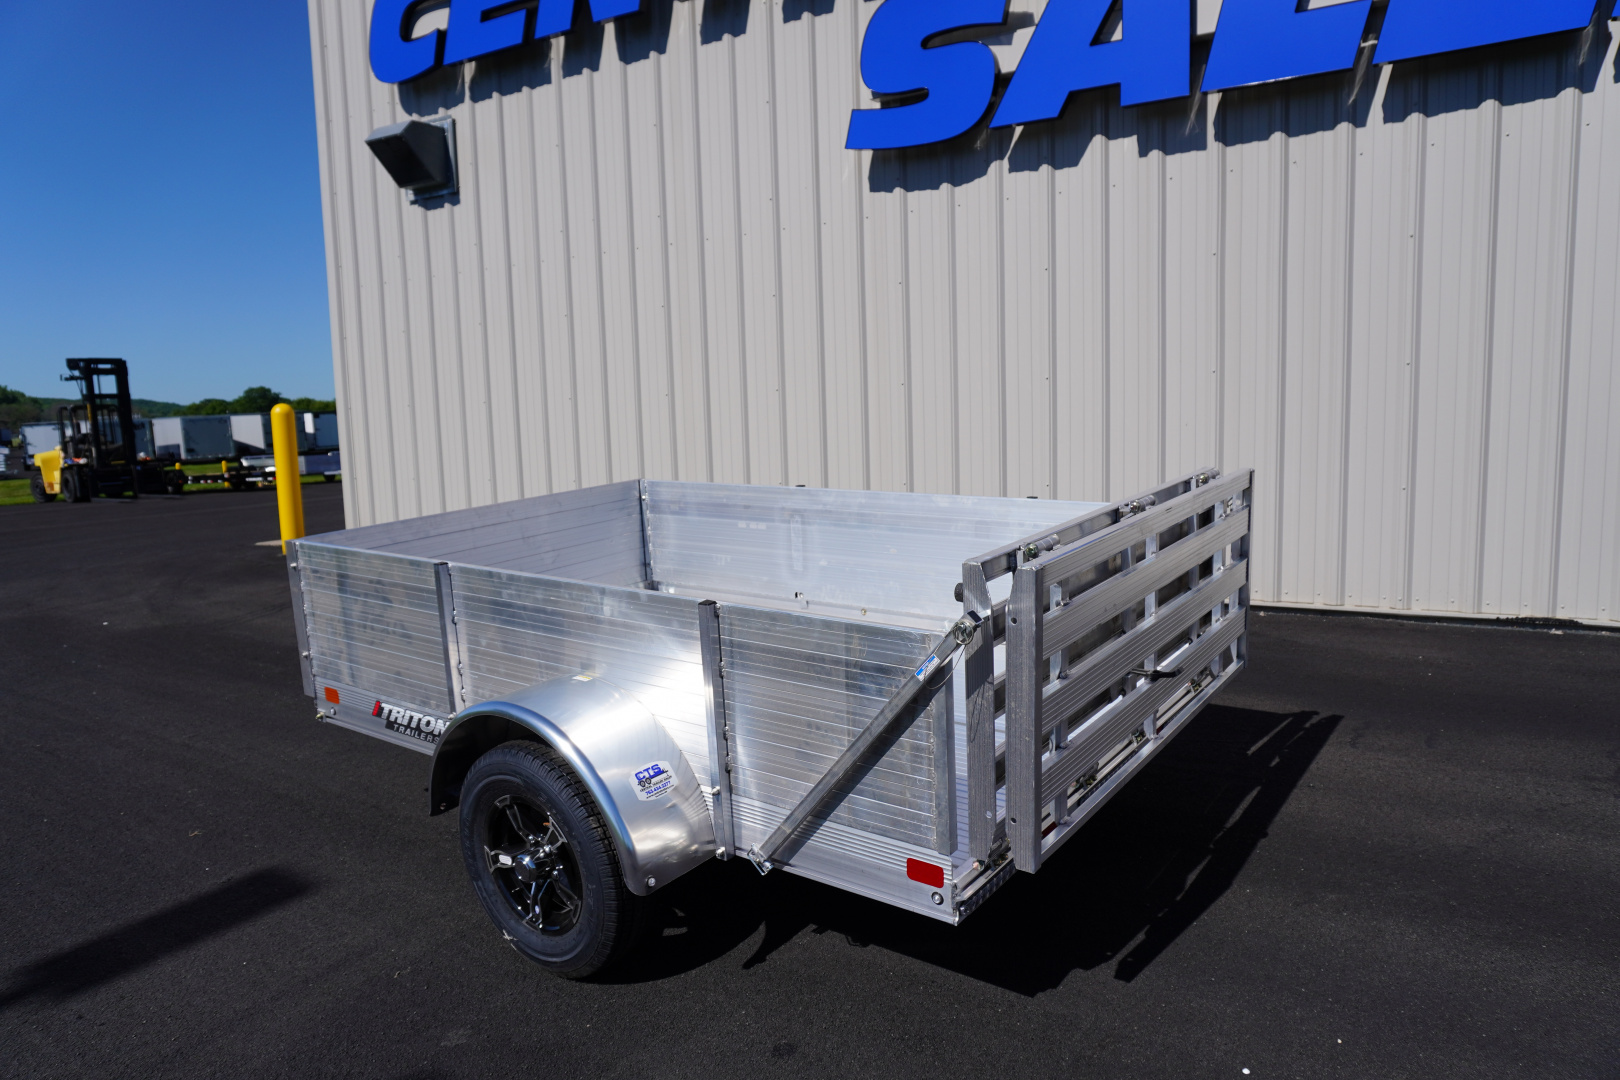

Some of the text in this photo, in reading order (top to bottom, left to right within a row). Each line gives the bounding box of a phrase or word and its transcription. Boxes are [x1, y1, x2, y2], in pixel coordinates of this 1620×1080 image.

[380, 702, 450, 736] TRITON
[394, 724, 441, 745] TRAILERS
[635, 764, 662, 781] CTS
